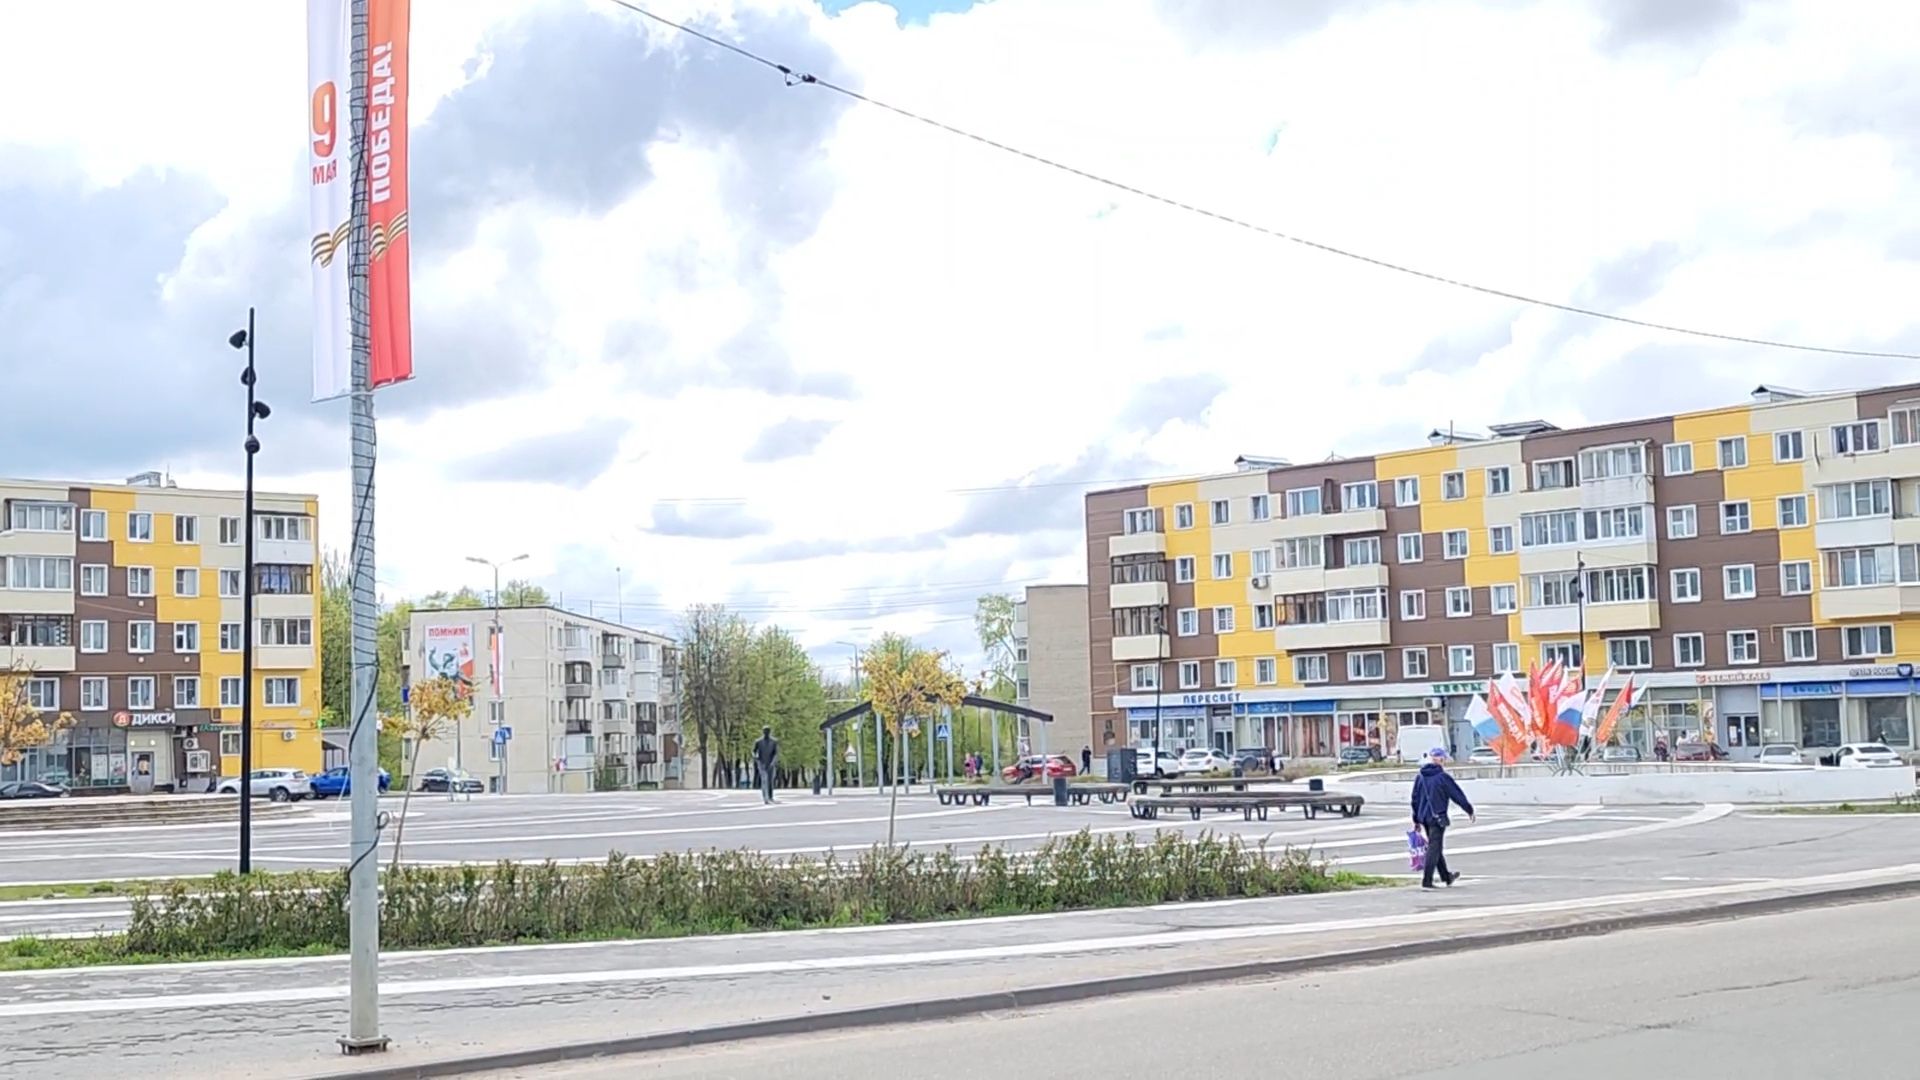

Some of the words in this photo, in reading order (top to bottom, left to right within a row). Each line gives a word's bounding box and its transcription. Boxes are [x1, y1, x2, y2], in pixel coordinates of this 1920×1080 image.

[312, 81, 336, 157] 9
[371, 41, 395, 204] ПОБЕДА!
[313, 159, 337, 185] МАЯ
[428, 627, 470, 638] ПОМНИМ!
[1182, 692, 1241, 704] ПЕРЕСВЕТ
[131, 712, 176, 726] ДИКСИ
